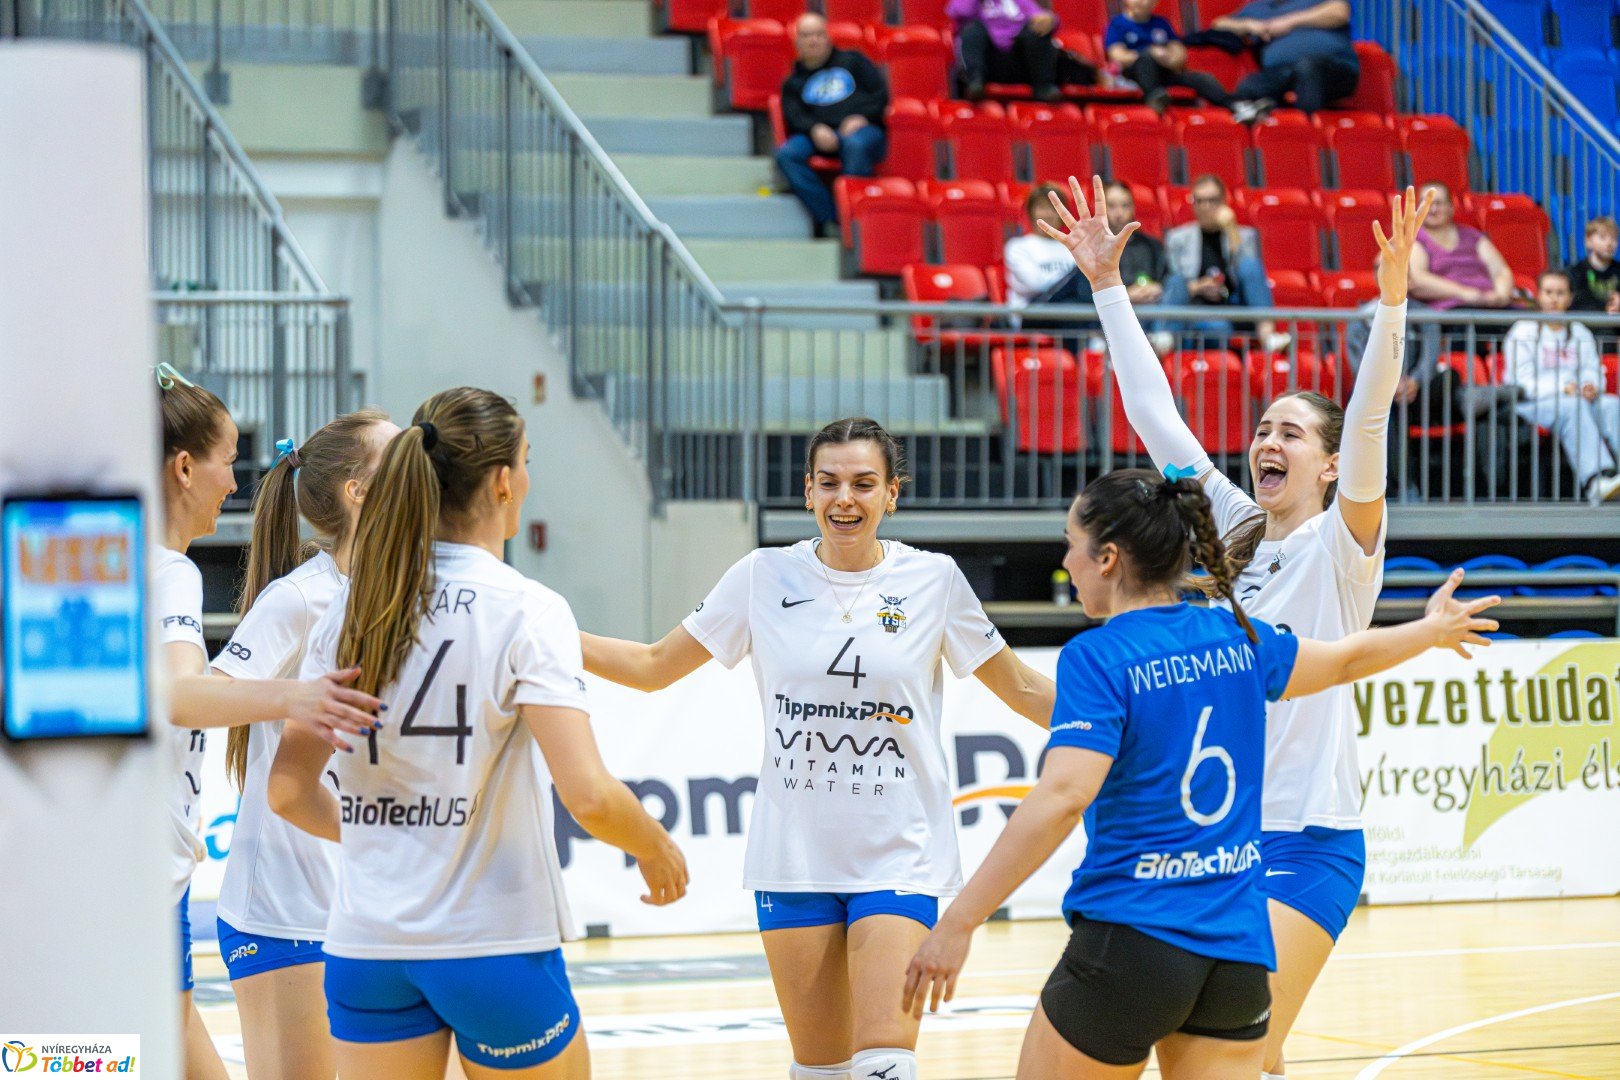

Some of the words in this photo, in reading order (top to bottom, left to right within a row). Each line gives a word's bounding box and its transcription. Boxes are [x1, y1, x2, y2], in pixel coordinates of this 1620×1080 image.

[826, 637, 866, 689] 4
[1127, 643, 1256, 695] WEIDEMANN
[775, 694, 914, 725] TippmixPRO
[774, 757, 905, 779] VITAMIN
[784, 778, 884, 796] WATER
[1180, 705, 1236, 827] 6
[1358, 743, 1566, 814] yíregyházi
[476, 1013, 570, 1059] TippmixPRO
